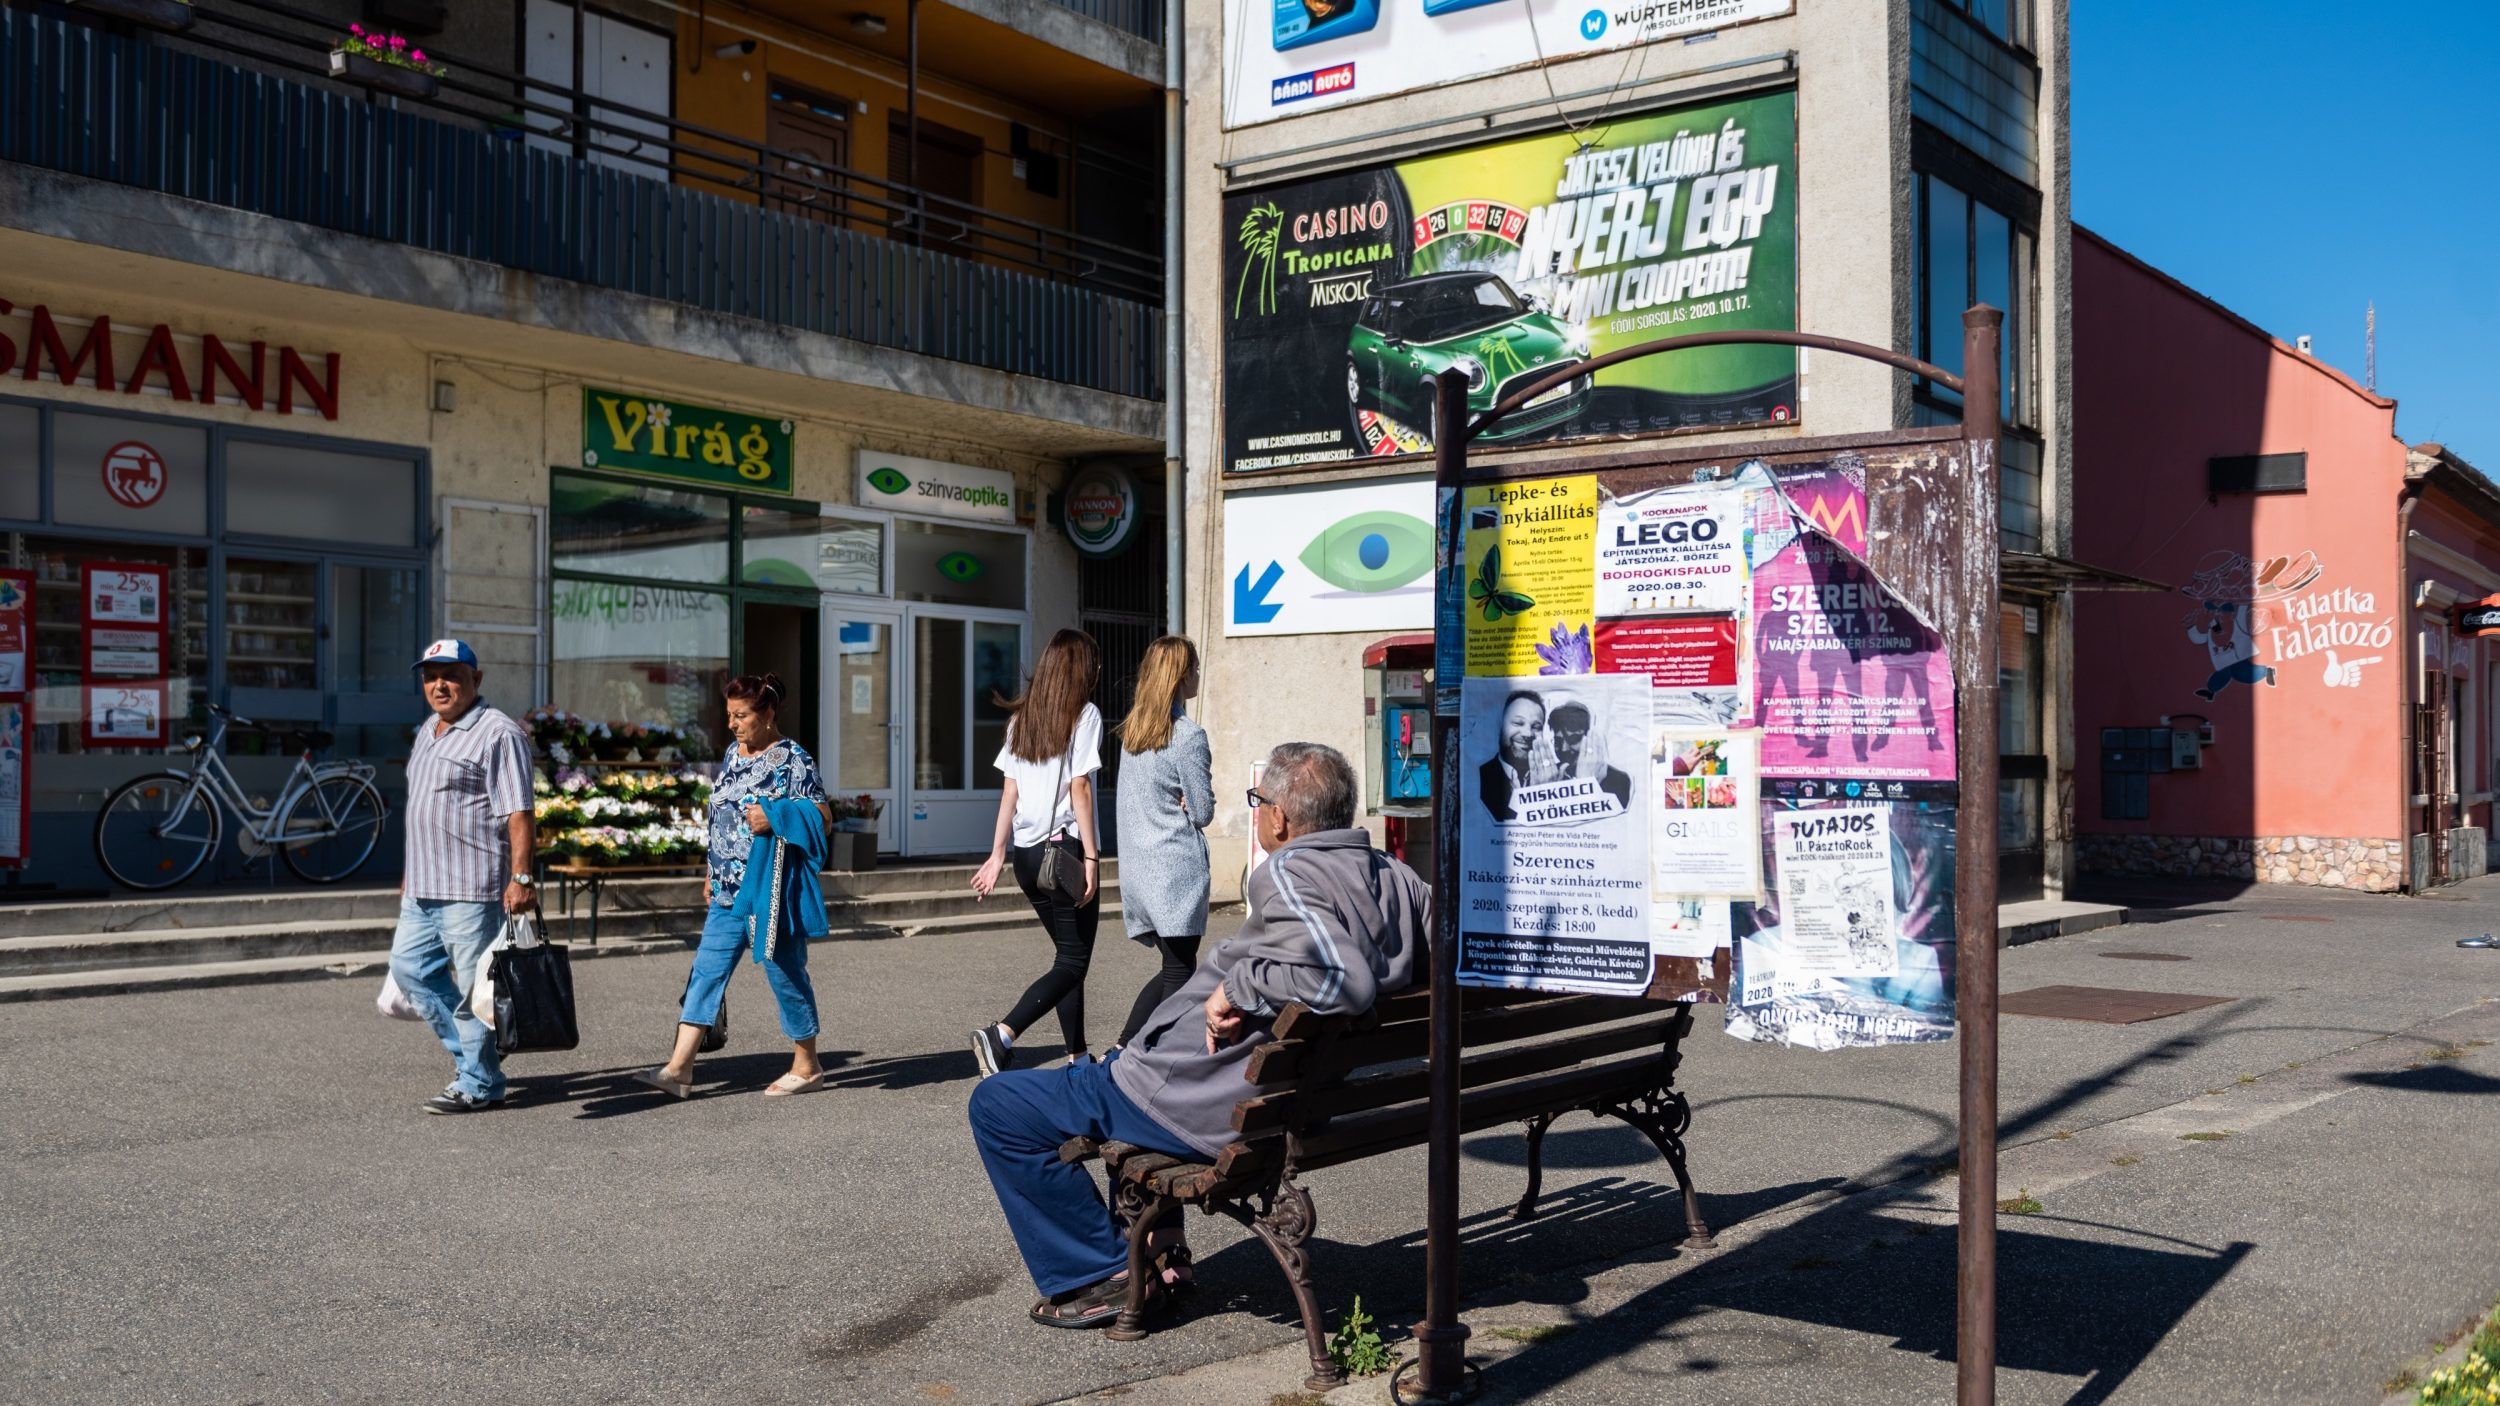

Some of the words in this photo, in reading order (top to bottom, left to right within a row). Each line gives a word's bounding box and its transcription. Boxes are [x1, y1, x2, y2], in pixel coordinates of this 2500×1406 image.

[1614, 0, 1741, 25] WÜRTEMBE
[1645, 16, 1691, 32] ABSOLUT
[1696, 5, 1745, 21] PERFEKT
[1273, 79, 1313, 101] BÁRDI
[1315, 68, 1352, 92] AUTÓ
[1715, 118, 1745, 174] ÉS
[1293, 200, 1388, 243] CASINO
[1415, 224, 1426, 240] 3
[1430, 213, 1446, 232] 26
[1454, 208, 1462, 225] 0
[1469, 207, 1486, 224] 32
[1488, 208, 1503, 227] 15
[1506, 214, 1521, 234] 19
[1515, 182, 1678, 282] NYERJ
[1682, 165, 1779, 251] EGY
[1551, 271, 1619, 322] MINI
[1690, 295, 1751, 320] 2020.10.17.
[1775, 411, 1785, 421] 18
[597, 396, 772, 480] Virág
[1248, 430, 1342, 451] WWW.CASINOMISKOLC.HU
[1235, 449, 1354, 471] FACEBOOK.COM/CASINOMISKOLC
[918, 478, 1009, 508] szinvaoptika
[1489, 485, 1545, 505] Lepke-
[1551, 481, 1568, 497] és
[1503, 503, 1594, 528] nykiállítás
[1642, 505, 1708, 517] KOCKANAPOK
[1532, 537, 1546, 545] Ady
[1616, 518, 1718, 547] LEGO
[1603, 547, 1668, 558] ÉPÍTMÉNYEK
[1672, 542, 1732, 553] KIÁLLÍTÁSA
[1603, 564, 1731, 580] BODROGKISFALUD
[1627, 581, 1706, 592] 2020.08.30.
[1771, 583, 1900, 612] SZERENCS
[2282, 586, 2375, 624] Falatka
[1787, 612, 1859, 635] SZEPT.
[1867, 612, 1895, 633] 12.
[1768, 637, 1865, 653] VÁR/SZABADTÉRI
[1869, 636, 1912, 649] SZÍNPAD
[2271, 615, 2395, 662] Falatozó
[1518, 783, 1594, 805] MISKOLCI
[1527, 800, 1612, 822] GYÖKEREK
[1791, 813, 1875, 839] TUTAJOS
[1544, 840, 1578, 848] humorista
[1601, 842, 1618, 850] estje
[1809, 839, 1873, 852] PásztoRock
[1513, 851, 1595, 869] Szerencs
[1468, 870, 1547, 886] Rákóczi-vár
[1551, 873, 1643, 889] színházterme
[1472, 899, 1503, 912] 2020.
[1506, 902, 1578, 916] szeptember
[1582, 904, 1593, 916] 8.
[1597, 904, 1638, 918] (kedd)
[1513, 917, 1561, 931] Kezdés:
[1565, 921, 1596, 933] 18:00
[1466, 938, 1496, 948] Jegyek
[1553, 942, 1594, 953] Szerencsi
[1595, 945, 1645, 958] Művelődési
[1467, 949, 1517, 961] Központban
[1574, 956, 1607, 967] Galéria
[1609, 957, 1644, 970] Kávézó)
[1490, 963, 1542, 974] www.tixa.hu
[1544, 967, 1592, 977] weboldalon
[1594, 968, 1637, 981] kaphatók.
[1747, 986, 1773, 1001] 2020
